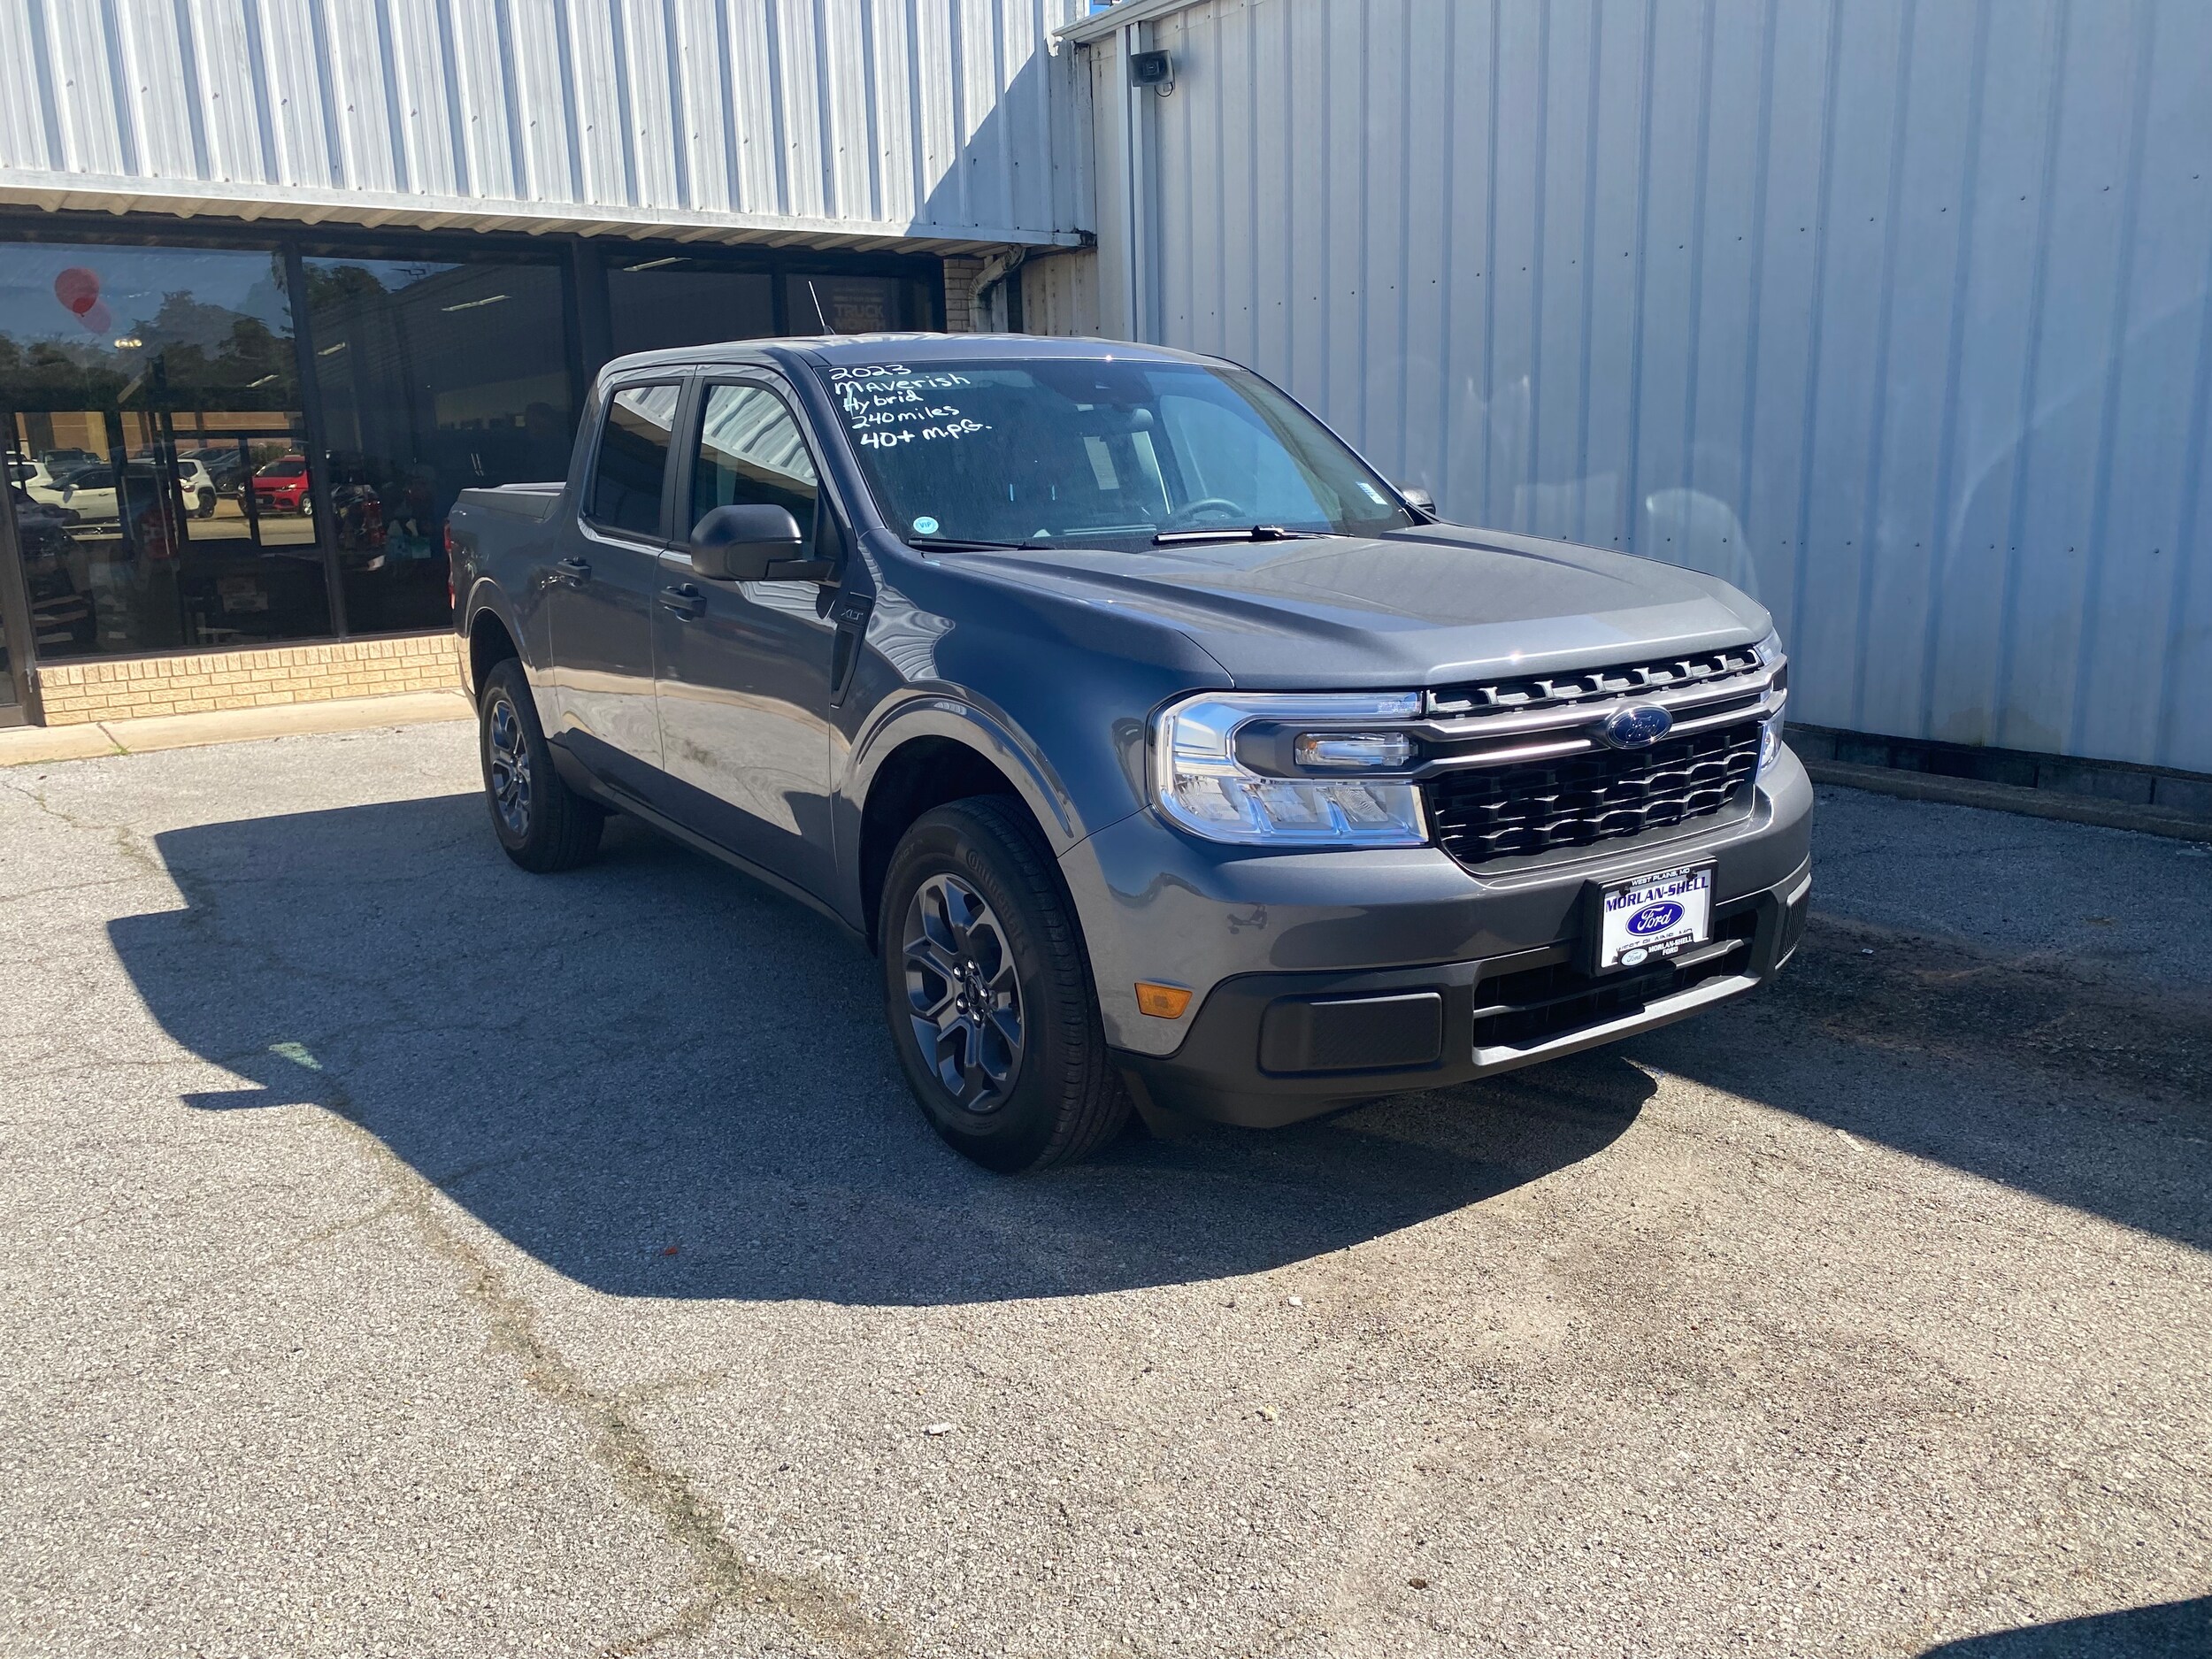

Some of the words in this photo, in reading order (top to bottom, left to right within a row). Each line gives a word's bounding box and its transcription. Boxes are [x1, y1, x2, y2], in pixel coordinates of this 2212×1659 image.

[833, 304, 884, 318] TRUCK
[828, 365, 912, 380] 2023
[843, 390, 924, 414] Hybrid
[860, 430, 916, 449] 40+
[841, 609, 864, 620] XLT
[1625, 714, 1660, 739] Ford
[1632, 876, 1652, 886] WEST
[1653, 871, 1678, 882] PLAINS,
[1606, 877, 1709, 912] MORLAN-SHELL
[1637, 906, 1672, 931] Ford
[1648, 936, 1693, 953] MORLAN-SHELL
[1663, 946, 1678, 956] FORD
[1627, 951, 1642, 963] Ford
